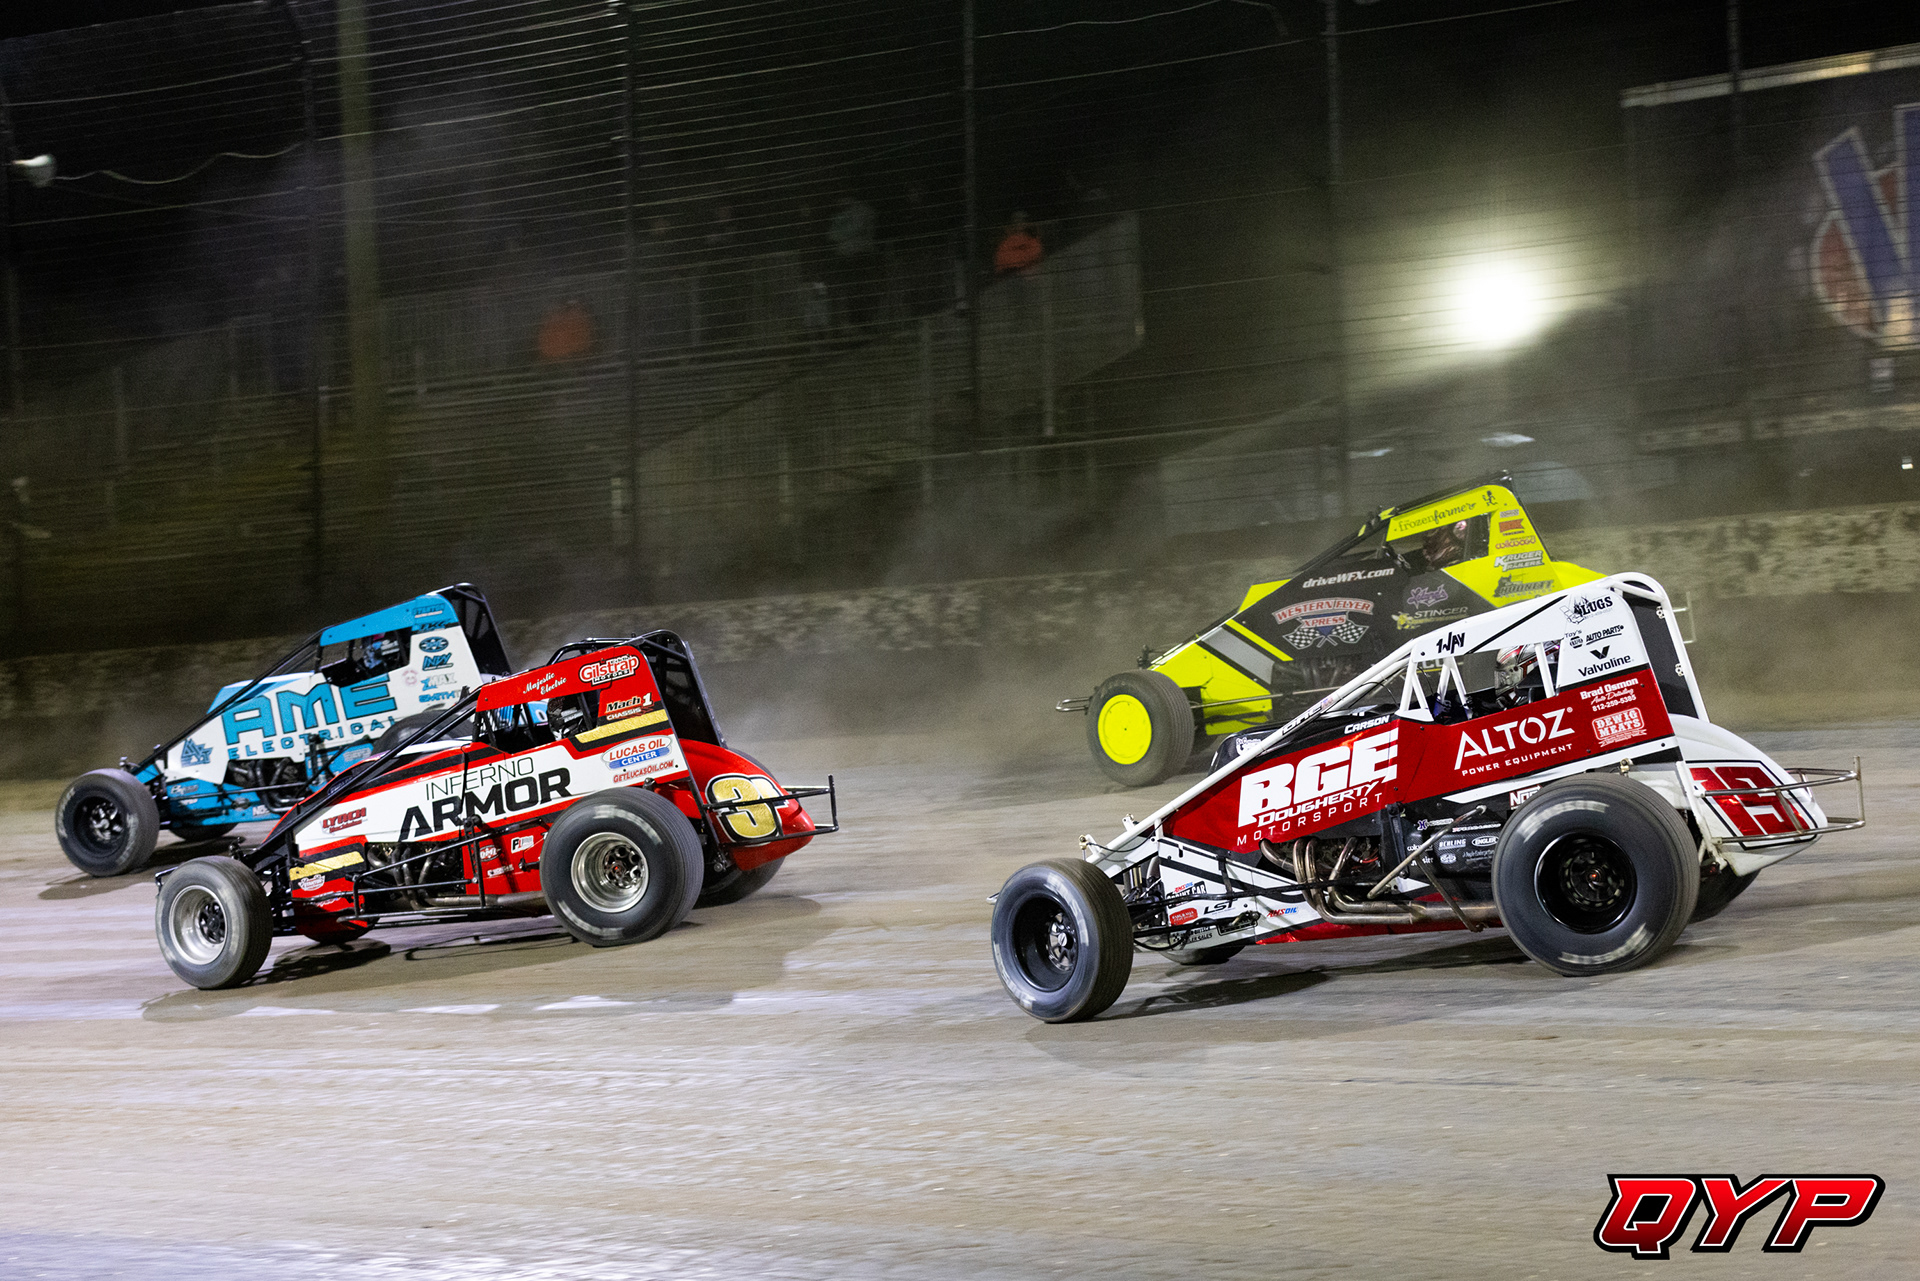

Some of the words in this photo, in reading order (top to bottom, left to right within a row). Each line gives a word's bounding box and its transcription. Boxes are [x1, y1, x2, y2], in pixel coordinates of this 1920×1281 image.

[1494, 550, 1543, 567] KRUGER
[1302, 567, 1394, 588] driveWFX.com
[1277, 600, 1333, 620] WESTERN
[1336, 600, 1371, 611] FLYER
[1414, 606, 1468, 619] STINGER
[1304, 616, 1346, 627] XPRESS
[1586, 631, 1602, 642] AUTO
[1602, 625, 1621, 636] PARTS
[580, 657, 639, 681] Gilstrap
[1578, 655, 1632, 677] Valvoline
[522, 672, 556, 695] Majestic
[540, 676, 568, 695] Electric
[1580, 686, 1604, 700] Brad
[1604, 678, 1639, 693] Osmon
[222, 673, 398, 746] AME
[607, 696, 641, 712] Mach
[642, 692, 653, 706] 1
[606, 707, 641, 721] CHASSIS
[1595, 710, 1638, 729] DEWIG
[1344, 715, 1391, 735] CARSON
[1598, 718, 1641, 738] MEATS
[609, 743, 646, 761] LUCAS
[648, 738, 666, 750] OIL
[1454, 708, 1575, 770] ALTOZ
[621, 751, 658, 766] CENTER
[1462, 762, 1500, 777] POWER
[1505, 743, 1573, 766] EQUIPMENT
[425, 756, 534, 801] INFERNO
[1237, 727, 1399, 828] BGE
[398, 767, 572, 842] ARMOR
[1257, 780, 1380, 828] DOUGHERTY
[1689, 766, 1811, 837] 19
[1236, 793, 1383, 846] MOTORSPORT
[1267, 906, 1298, 918] AMSOIL
